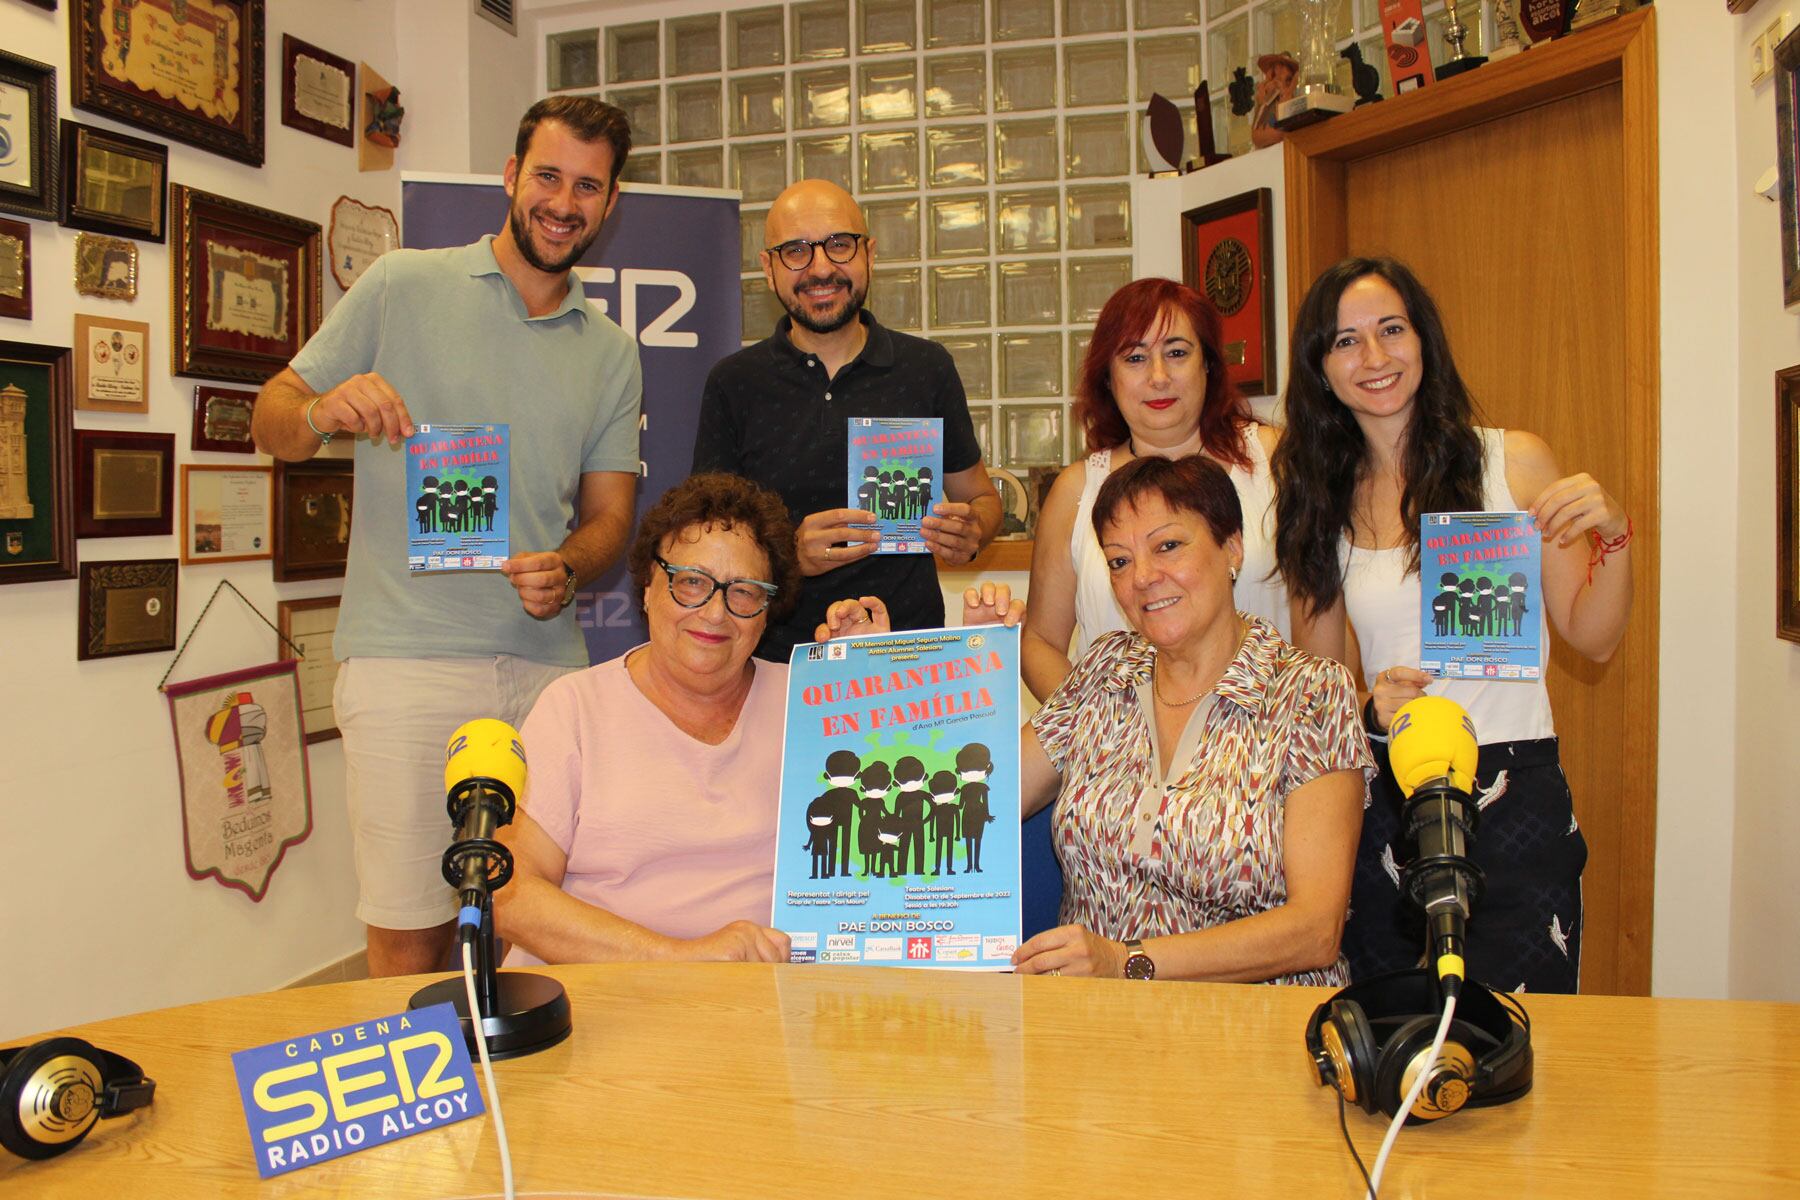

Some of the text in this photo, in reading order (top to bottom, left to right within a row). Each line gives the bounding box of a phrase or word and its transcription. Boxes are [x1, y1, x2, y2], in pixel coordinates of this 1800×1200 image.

[410, 434, 504, 455] QUARANTENA
[853, 428, 938, 446] QUARANTENA
[420, 458, 438, 470] EN
[1426, 523, 1535, 549] QUARANTENA
[1438, 553, 1459, 566] EN
[895, 638, 916, 646] Miguel
[802, 651, 1004, 706] QUARANTENA
[822, 688, 994, 737] EN FAMÍLIA
[970, 710, 996, 720] Pascual
[836, 890, 857, 898] dirigit
[839, 920, 954, 932] PAE DON BOSCO
[828, 938, 854, 946] nirvel
[285, 1016, 412, 1057] CADENA
[253, 1031, 464, 1143] SER
[268, 1092, 468, 1169] RADIO ALCOY
